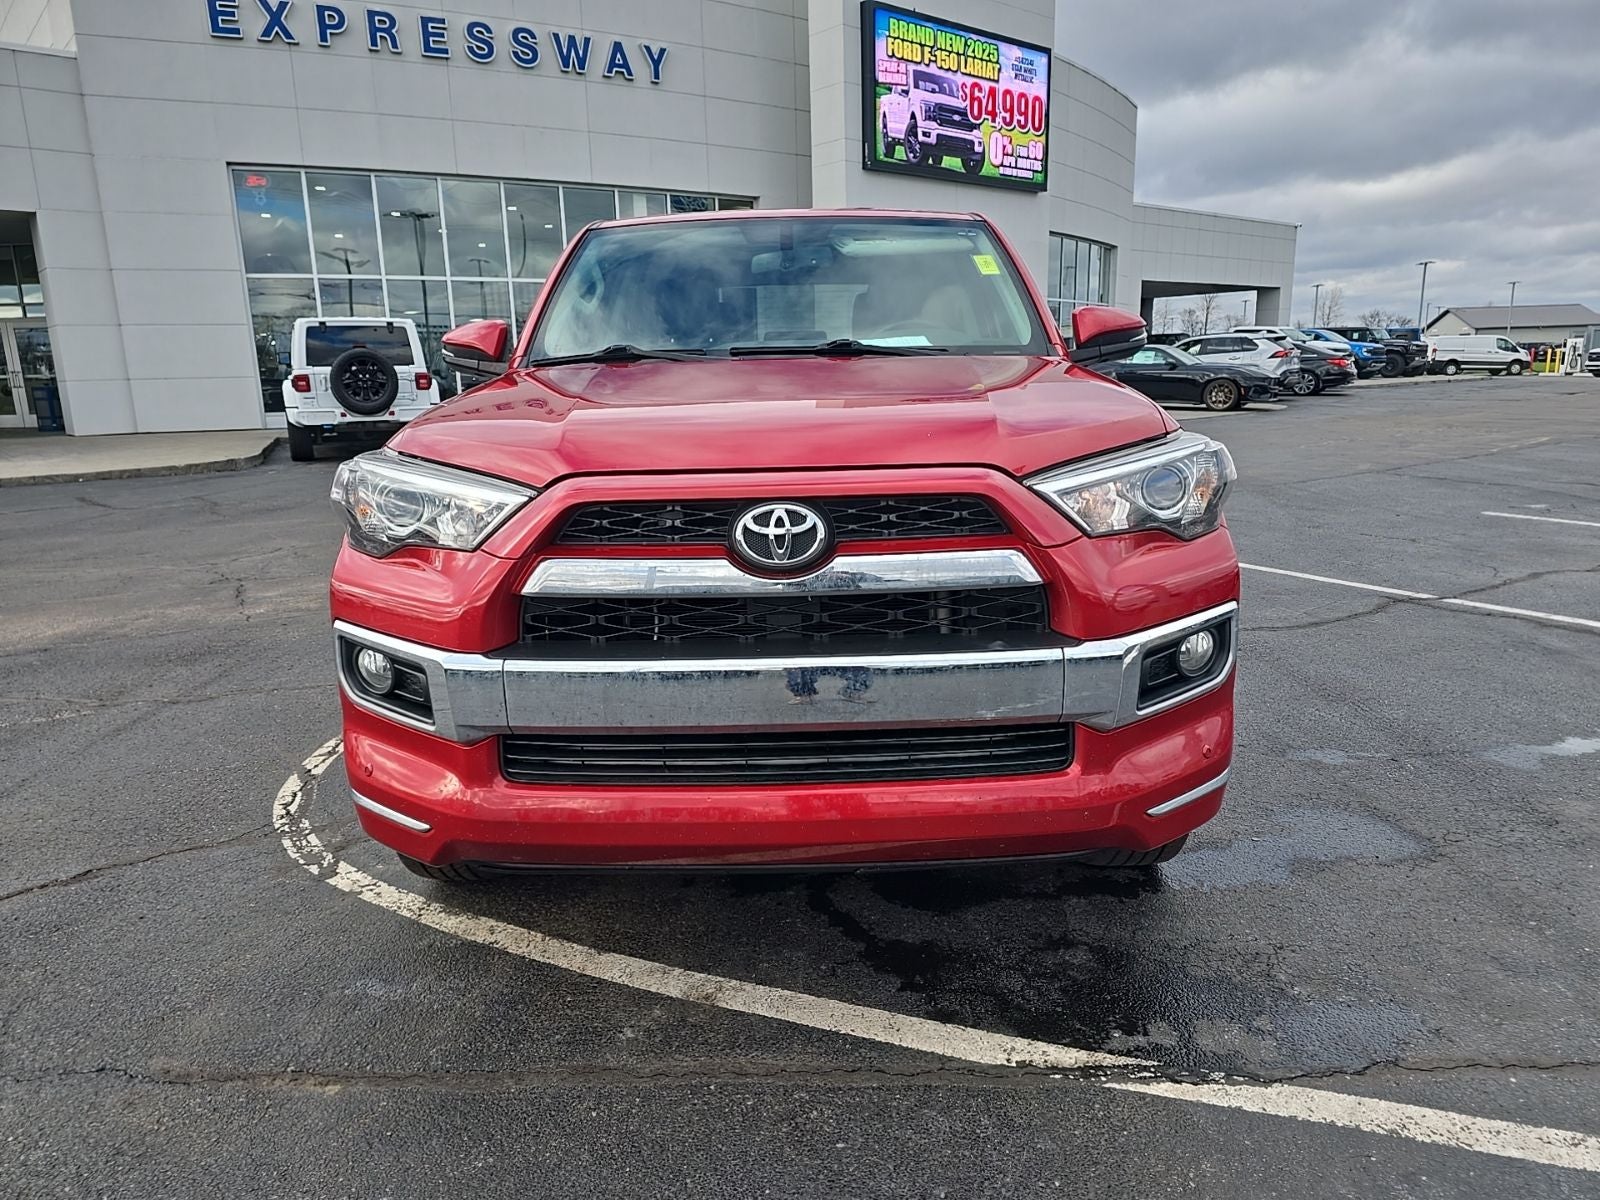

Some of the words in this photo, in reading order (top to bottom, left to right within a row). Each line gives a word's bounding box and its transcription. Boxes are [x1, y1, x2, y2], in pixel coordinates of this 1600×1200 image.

[206, 0, 669, 83] EXPRESSWAY
[887, 37, 923, 63] FORD
[923, 47, 959, 73] F-150
[960, 56, 1001, 82] LARIAT
[889, 18, 935, 47] BRAND
[936, 29, 966, 56] NEW
[966, 39, 999, 62] 2025
[1028, 140, 1044, 160] 60
